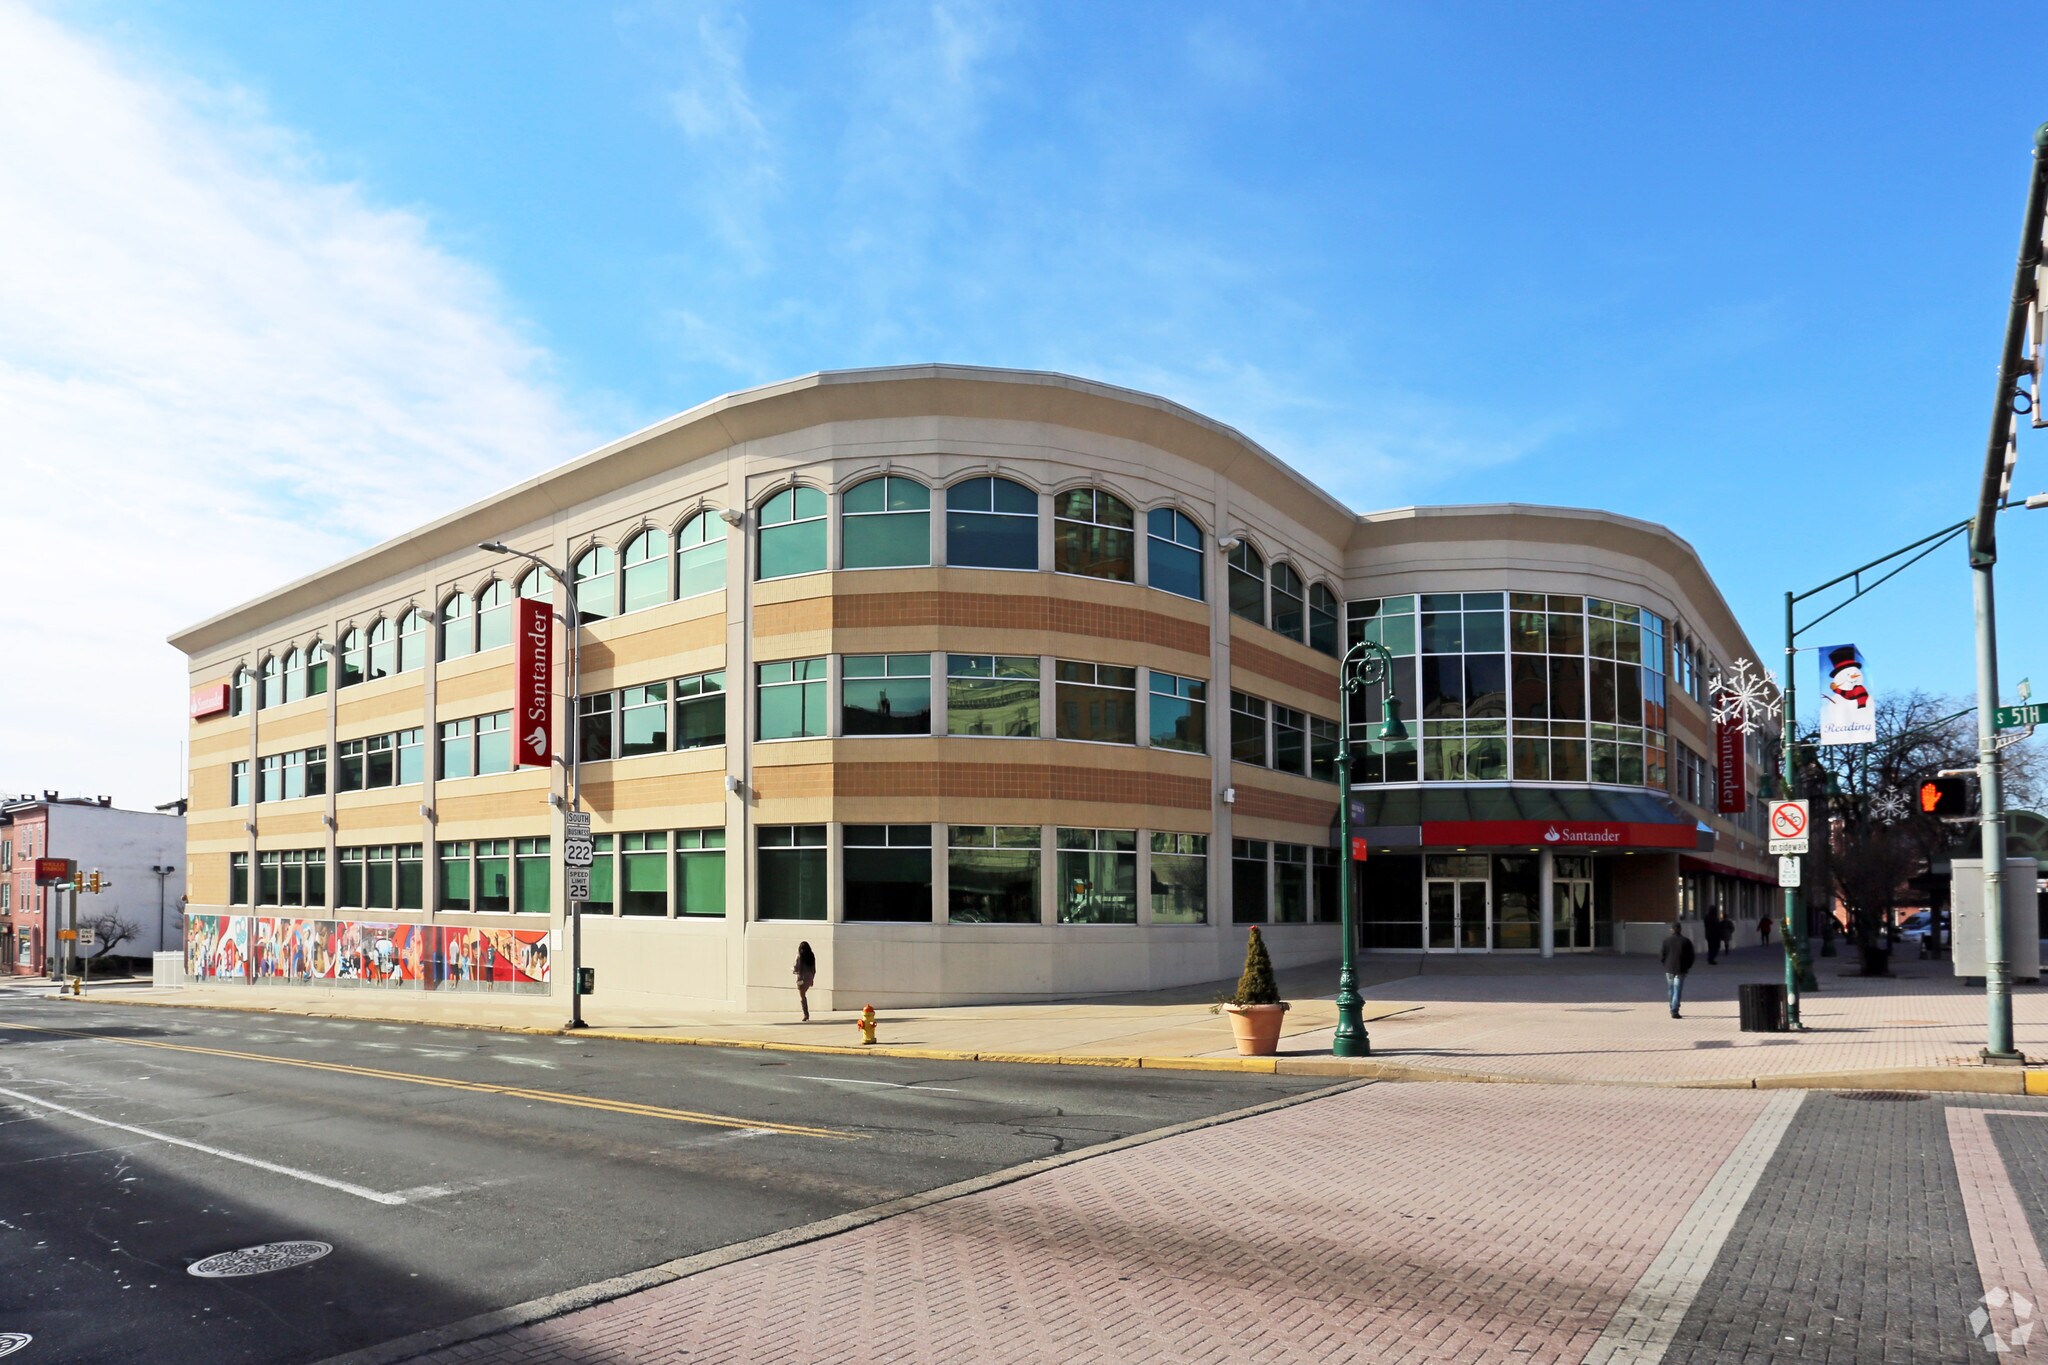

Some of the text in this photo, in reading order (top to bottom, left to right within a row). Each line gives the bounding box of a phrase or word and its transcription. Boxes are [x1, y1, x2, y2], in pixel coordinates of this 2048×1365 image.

[528, 610, 547, 722] Santander
[1997, 706, 2040, 725] S 5TH
[1824, 721, 1872, 733] Reading
[1722, 725, 1739, 806] Santander
[568, 813, 589, 823] SOUTH
[568, 828, 589, 837] BUSINESS
[1562, 828, 1620, 842] Santander
[568, 845, 590, 860] 222
[570, 885, 588, 897] 25
